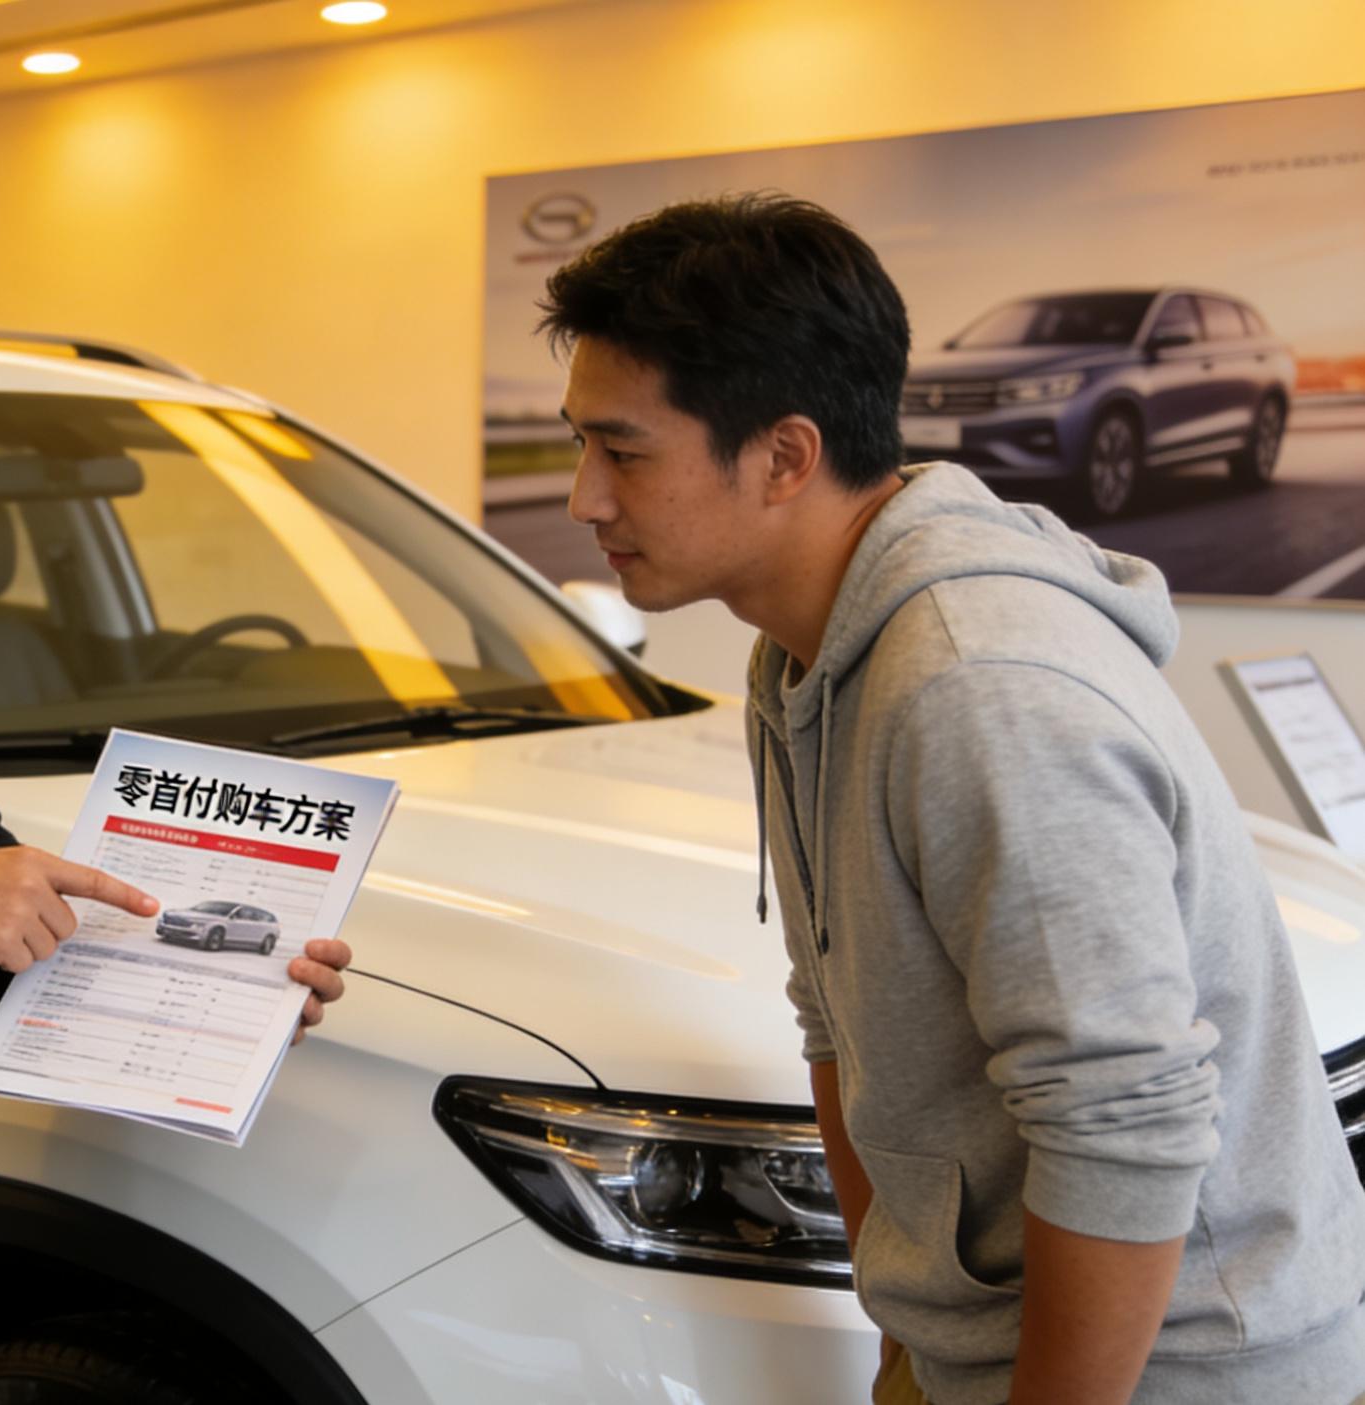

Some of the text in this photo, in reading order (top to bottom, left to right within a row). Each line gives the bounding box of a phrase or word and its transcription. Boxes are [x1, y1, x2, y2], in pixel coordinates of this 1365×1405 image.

[114, 765, 355, 841] 零首付购车方案
